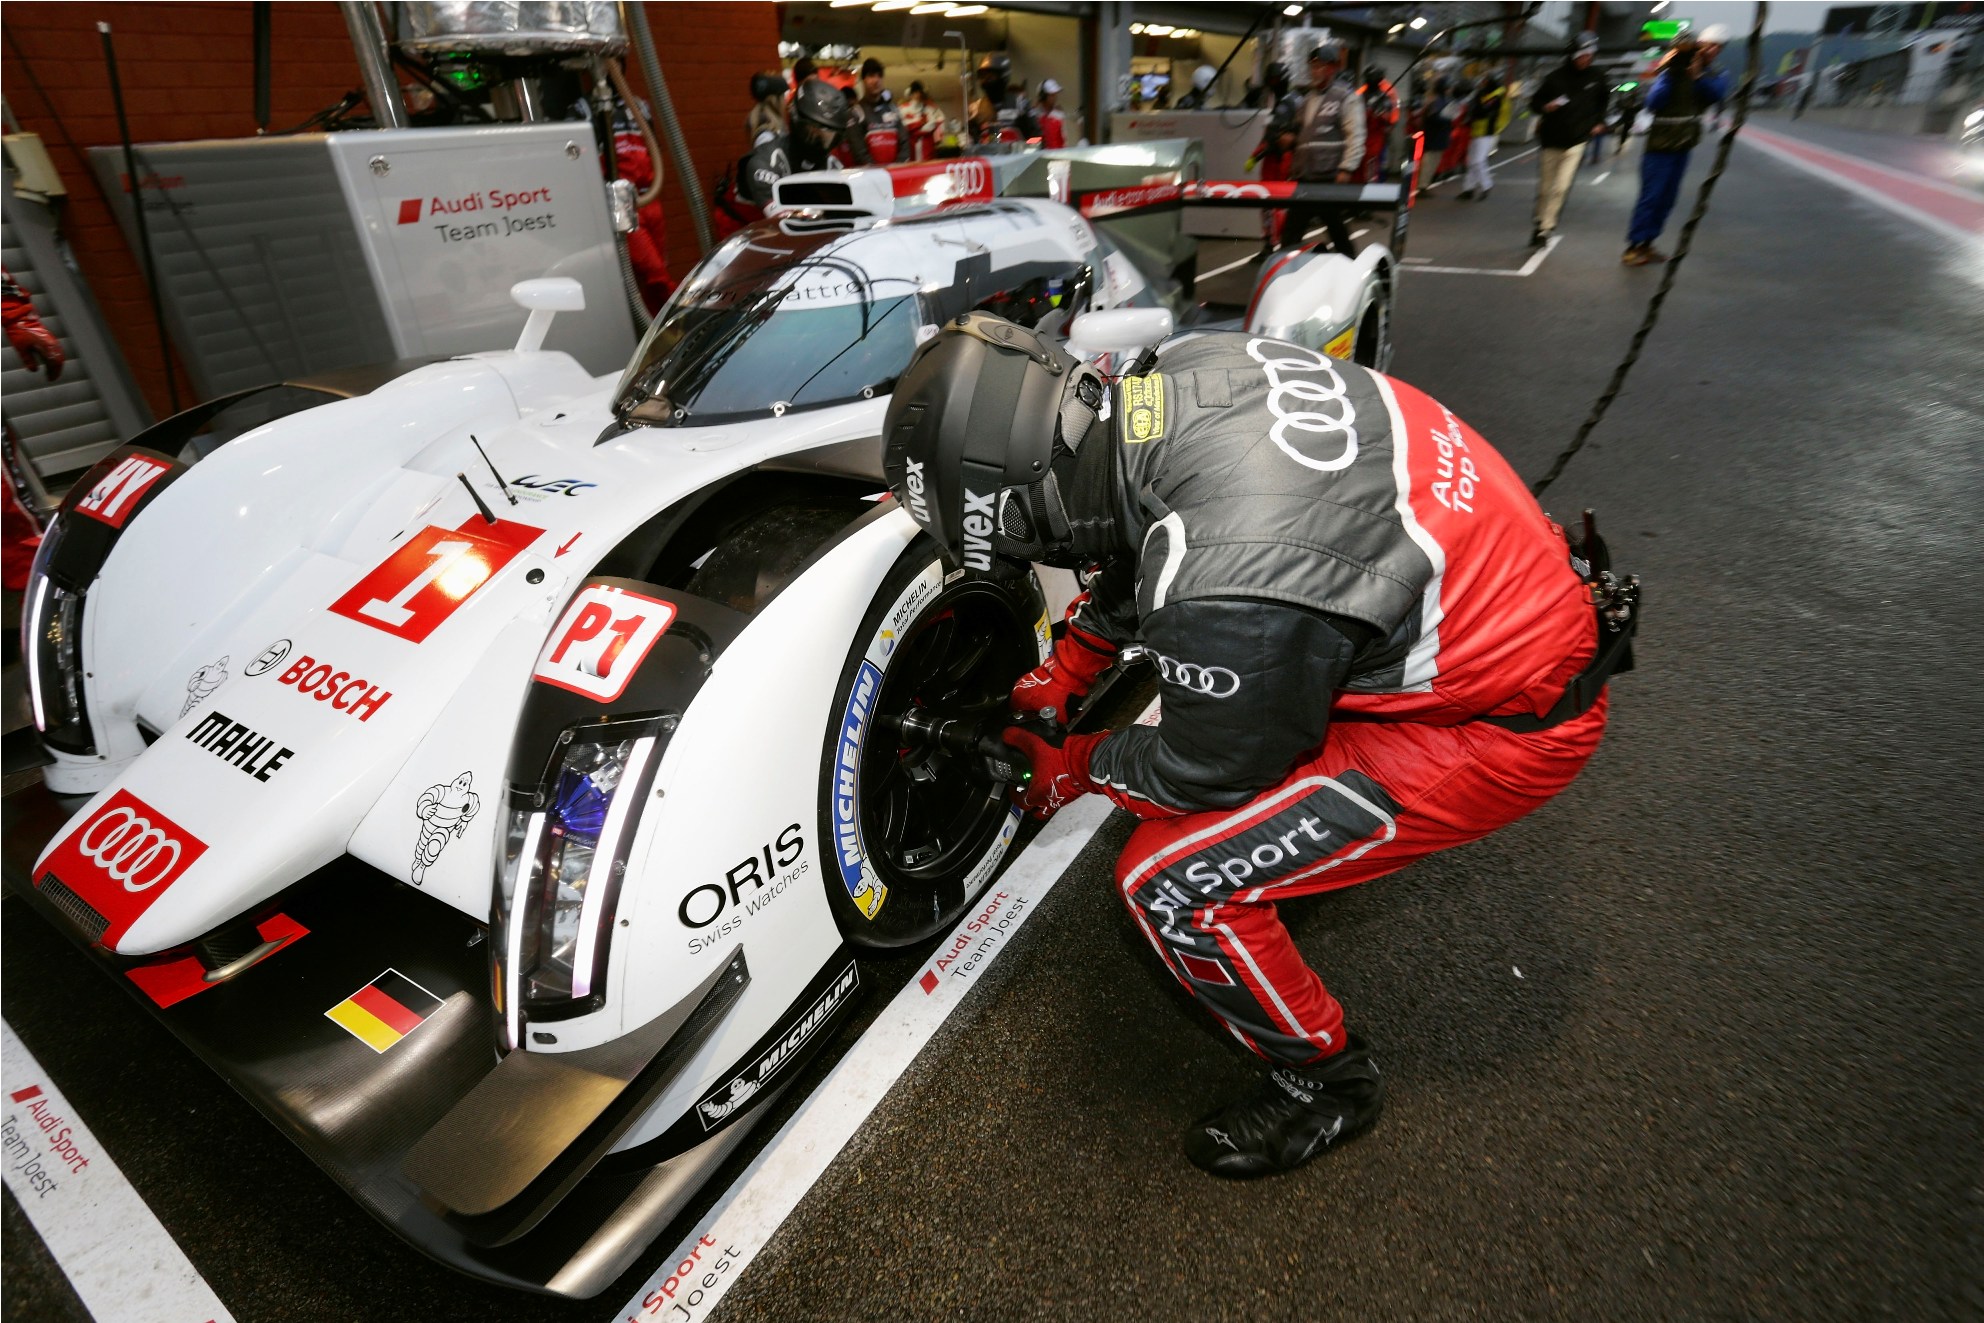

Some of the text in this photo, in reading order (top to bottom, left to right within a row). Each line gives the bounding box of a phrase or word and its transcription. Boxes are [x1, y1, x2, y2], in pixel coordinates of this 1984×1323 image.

[430, 186, 552, 217] Audi Sport
[434, 213, 558, 243] Team Joest
[906, 456, 931, 523] uvex
[1430, 428, 1453, 508] Audi
[1452, 456, 1480, 513] Top
[963, 487, 996, 572] uvex
[358, 541, 473, 628] 1
[892, 579, 928, 627] MICHELIN
[896, 581, 942, 635] Total Performance
[549, 600, 647, 680] P1
[277, 655, 393, 723] BOSCH
[185, 710, 296, 783] MAHLE
[838, 668, 875, 868] MICHELIN
[678, 822, 804, 929] ORIS
[1185, 816, 1331, 894] Sport
[688, 860, 809, 955] Swiss Watches
[936, 891, 1009, 973] Audi Sport
[950, 896, 1029, 978] Team Joest
[759, 968, 854, 1079] MICHELIN
[1, 1114, 59, 1198] Team Joest
[26, 1098, 91, 1174] Audi Sport
[641, 1232, 717, 1315] Sport
[672, 1244, 742, 1322] Joest
